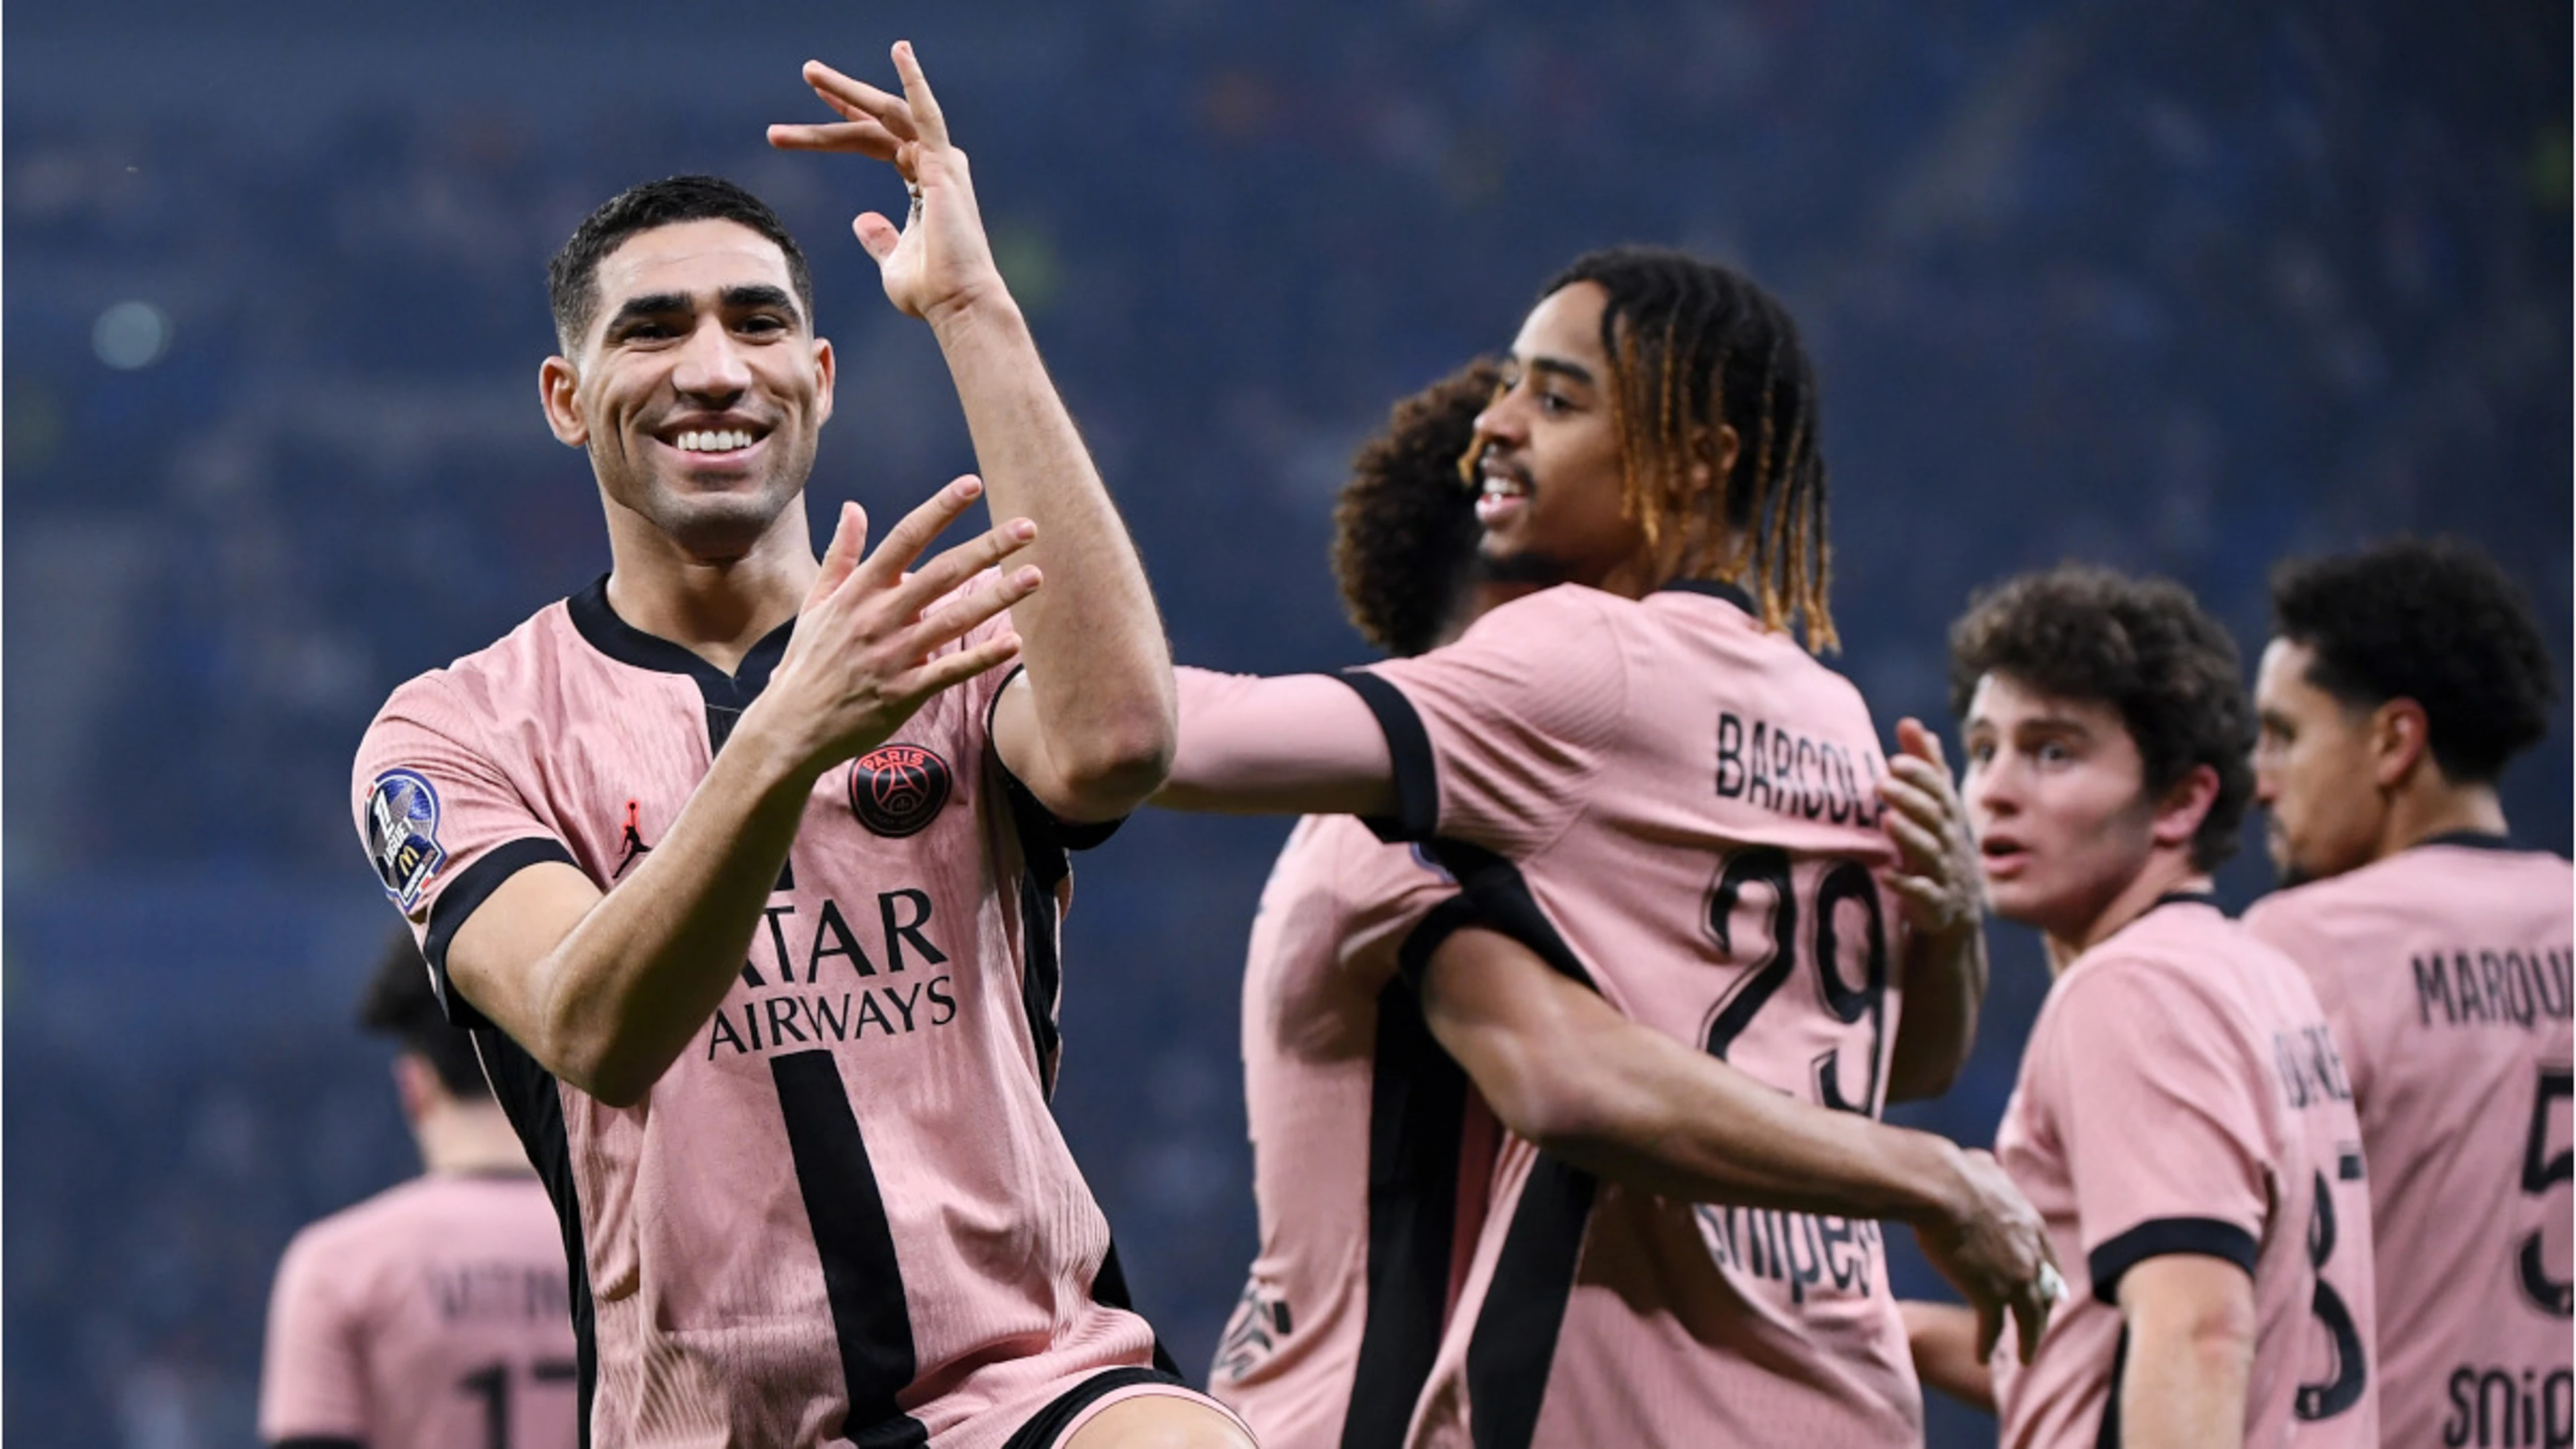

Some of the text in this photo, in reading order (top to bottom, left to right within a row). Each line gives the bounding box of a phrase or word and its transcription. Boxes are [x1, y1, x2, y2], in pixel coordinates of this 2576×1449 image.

[863, 750, 924, 771] PARIS
[740, 888, 949, 989] TAR
[1698, 844, 1888, 1118] 29
[708, 975, 957, 1061] AIRWAYS
[2516, 1065, 2575, 1318] 5
